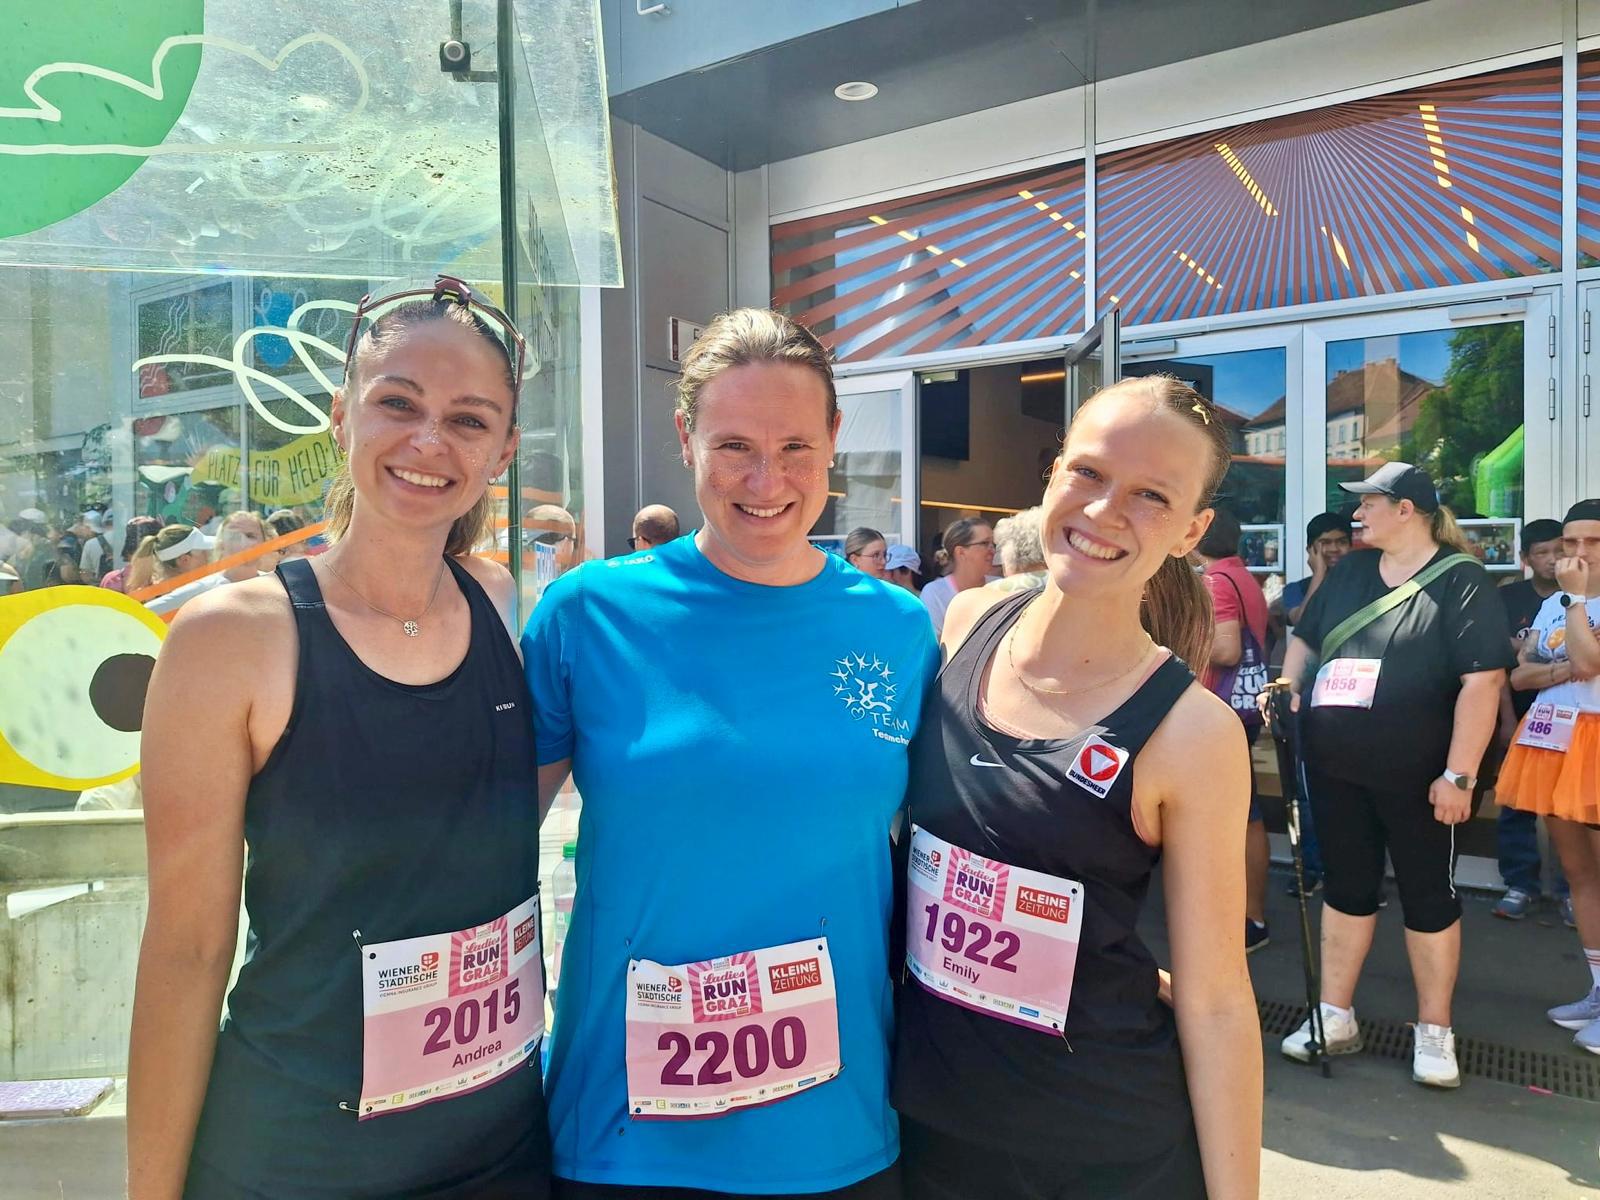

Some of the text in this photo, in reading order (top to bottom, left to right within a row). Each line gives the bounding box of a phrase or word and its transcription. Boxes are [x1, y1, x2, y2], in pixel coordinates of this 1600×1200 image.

[208, 452, 241, 486] PLATZ
[254, 455, 279, 497] FÜR
[1232, 670, 1268, 694] RUN
[1325, 678, 1357, 691] 1858
[1230, 694, 1258, 710] GR
[1528, 720, 1552, 735] 486
[1068, 769, 1107, 795] BUNDESHEER
[912, 847, 931, 862] WIENER
[961, 863, 996, 883] Ladies
[956, 870, 994, 898] RUN
[954, 886, 992, 909] GRAZ
[1020, 889, 1068, 910] KLEINE
[1018, 902, 1067, 921] ZEITUNG
[514, 915, 535, 939] KLEINE
[466, 937, 500, 952] Ladies
[925, 902, 1021, 974] 1922
[463, 944, 500, 971] RUN
[378, 965, 420, 979] WIENER
[378, 970, 438, 989] STÄDTISCHE
[462, 960, 499, 983] GRAZ
[703, 970, 746, 985] Ladies
[771, 961, 818, 980] KLEINE
[943, 956, 981, 984] Emily
[637, 983, 667, 992] WIENER
[703, 978, 747, 1001] RUN
[773, 974, 819, 992] ZEITUNG
[637, 991, 681, 1003] STÄDTISCHE
[705, 995, 749, 1013] GRAZ
[422, 977, 521, 1056] 2015
[452, 1040, 502, 1069] Andrea
[657, 1016, 807, 1086] 2200
